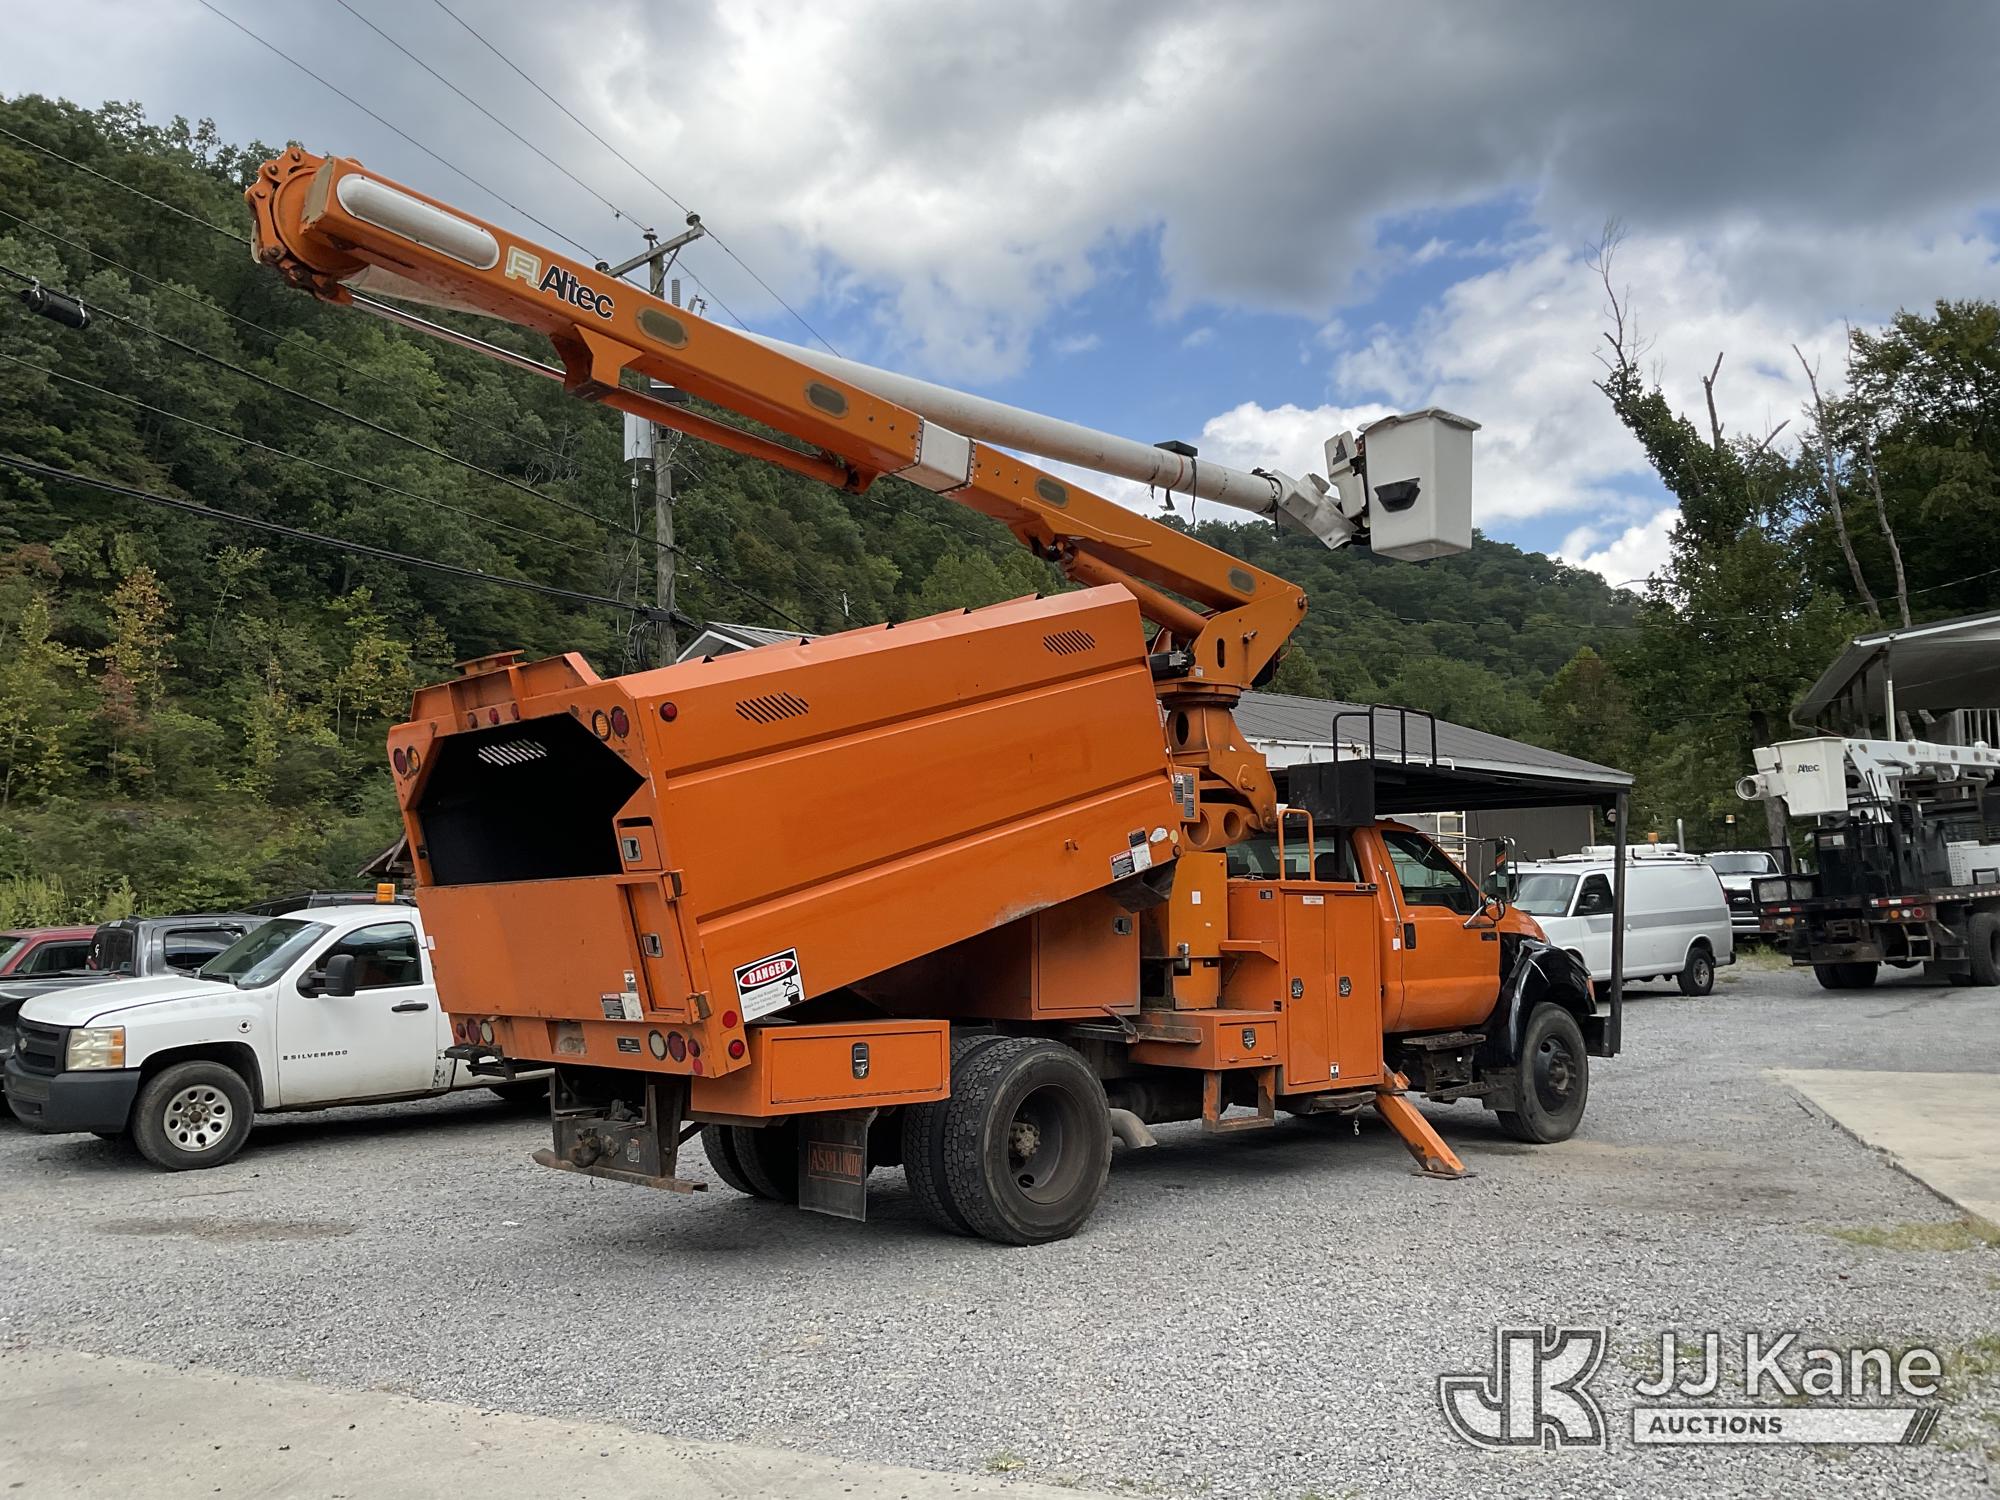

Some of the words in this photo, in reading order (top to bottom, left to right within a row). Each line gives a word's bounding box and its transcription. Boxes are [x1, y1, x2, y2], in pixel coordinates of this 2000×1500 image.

[539, 264, 615, 319] Altec
[1797, 764, 1820, 773] Altec
[748, 961, 788, 984] DANGER
[290, 1050, 348, 1060] SILVERADO
